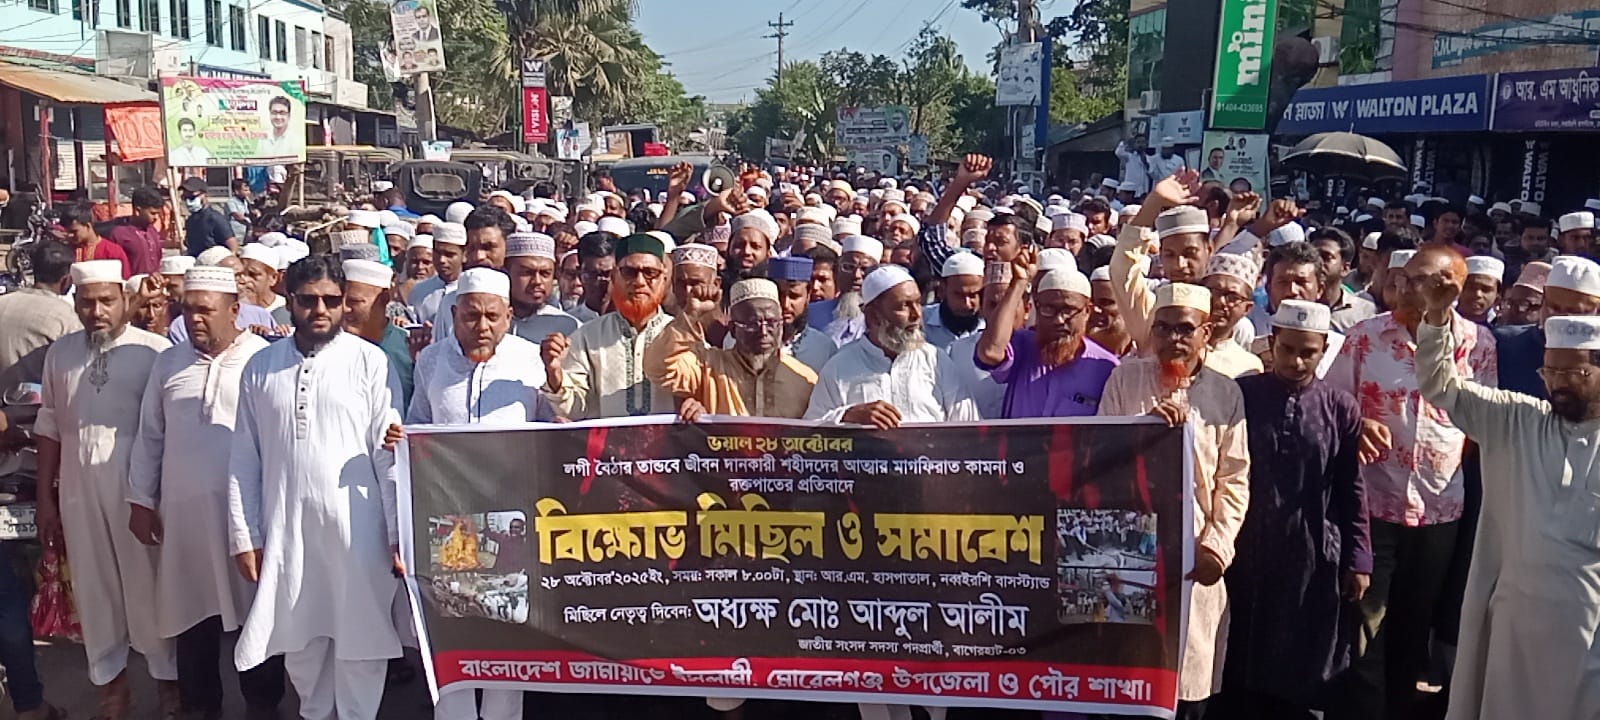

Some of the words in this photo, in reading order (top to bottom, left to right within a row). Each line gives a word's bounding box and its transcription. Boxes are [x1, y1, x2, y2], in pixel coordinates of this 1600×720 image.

[1228, 0, 1266, 86] min
[1356, 95, 1417, 119] WALTON
[1420, 92, 1478, 116] PLAZA
[1521, 151, 1534, 201] WALTO
[755, 437, 778, 452] ২৮
[781, 434, 853, 454] অক্টোবর
[564, 458, 590, 477] লগী
[595, 456, 632, 476] বৈঠার
[684, 453, 719, 473] জীবন
[724, 453, 776, 473] দানকারী
[781, 454, 839, 473] শহীদদের
[892, 455, 961, 475] মাগফিরাত
[964, 458, 1007, 475] কামনা
[1011, 461, 1025, 474] ও
[729, 477, 793, 493] রক্তপাতের
[797, 475, 855, 495] প্রতিবাদে
[535, 497, 688, 564] বিক্ষোভ
[696, 492, 825, 564] মিছিল
[836, 512, 863, 560] ও
[874, 513, 1045, 565] সমাবেশ
[541, 576, 561, 590] ২৮
[705, 569, 738, 582] সকাল
[564, 605, 607, 624] মিছিলে
[610, 606, 648, 625] নেতৃত্ব
[691, 598, 781, 629] অধ্যক্ষ
[787, 597, 840, 629] মোঃ
[847, 597, 932, 640] আব্দুল
[938, 592, 1030, 637] আলীম
[458, 659, 561, 680] বাংলাদেশ
[892, 666, 990, 695] উপজেলা
[999, 672, 1019, 696] ও
[1029, 667, 1080, 699] পৌর
